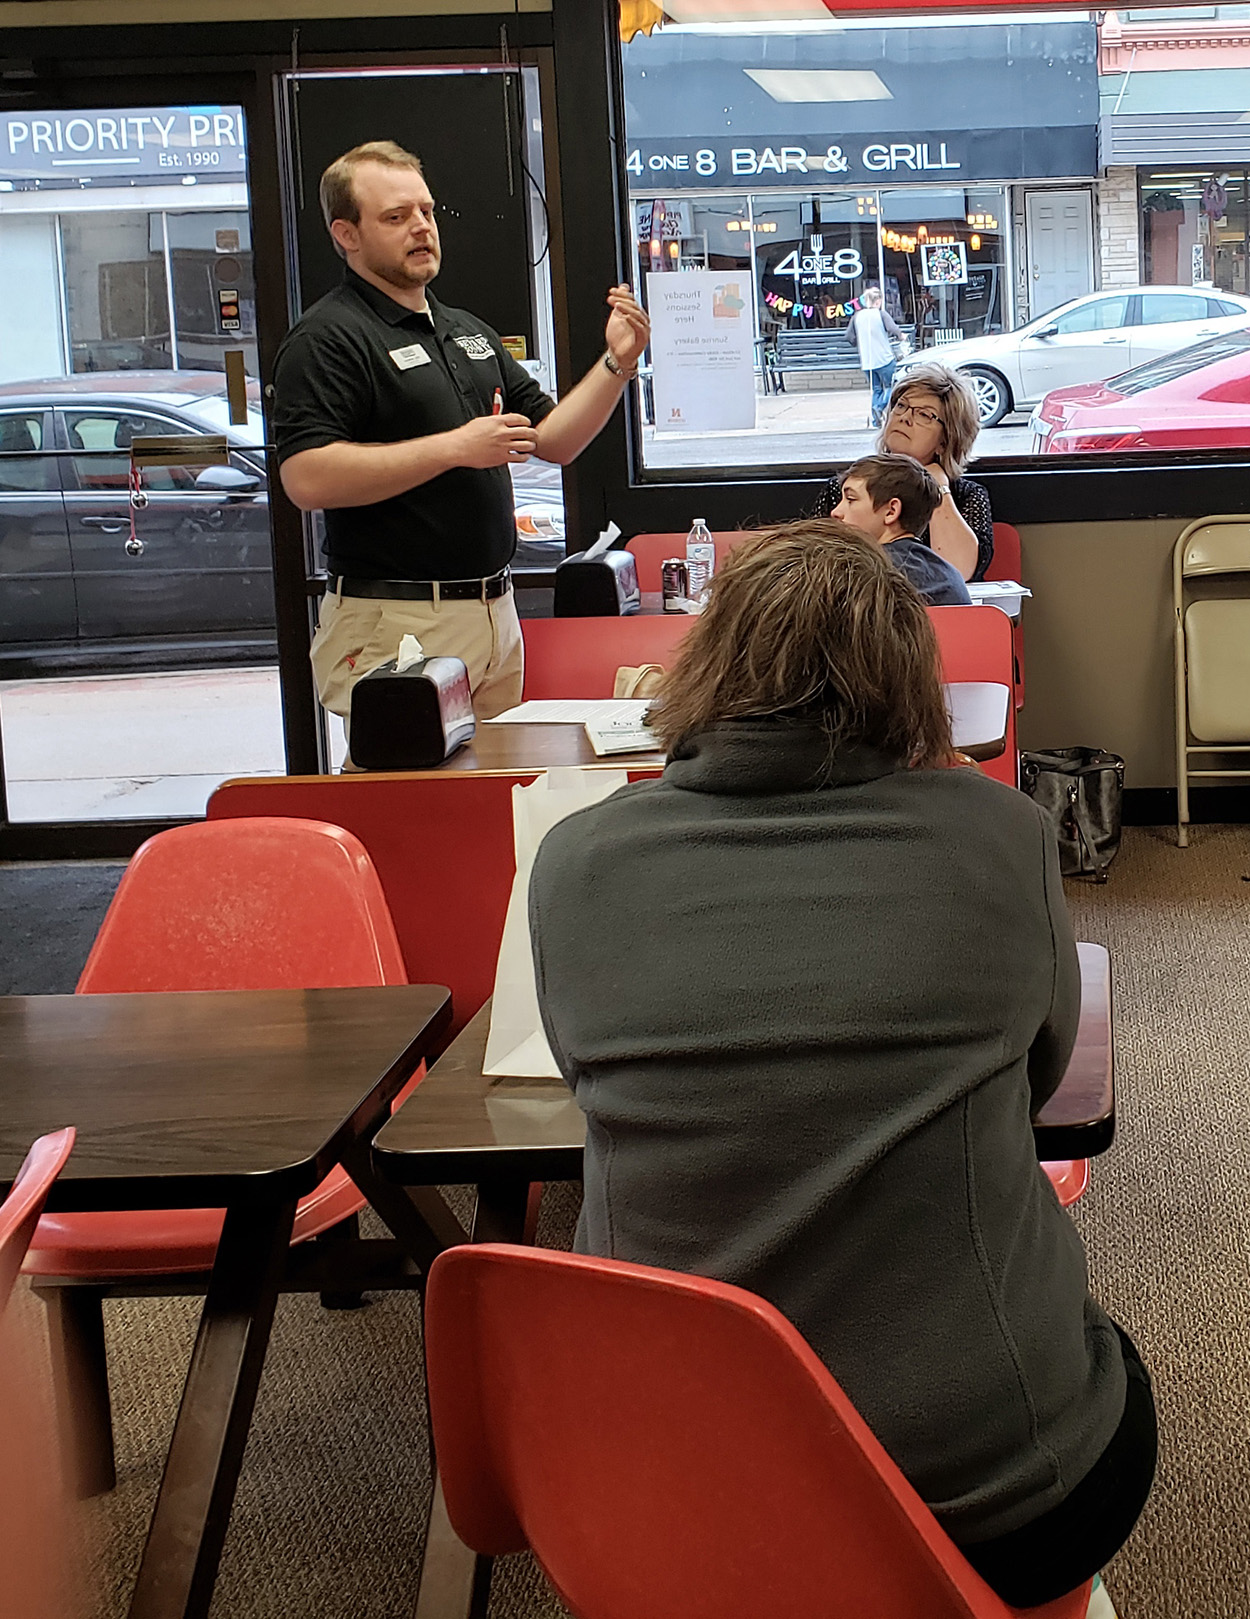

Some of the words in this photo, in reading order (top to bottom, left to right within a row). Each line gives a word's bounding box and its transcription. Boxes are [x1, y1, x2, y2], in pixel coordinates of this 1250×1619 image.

[7, 115, 176, 154] PRIORITY
[159, 153, 183, 167] Est.
[186, 151, 220, 166] 1990
[626, 149, 644, 176] 4
[648, 154, 690, 172] ONE
[695, 149, 717, 176] 8
[731, 147, 809, 176] BAR
[822, 145, 849, 173] &
[862, 143, 961, 171] GRILL
[773, 250, 804, 280] 4
[802, 258, 833, 271] ONE
[833, 248, 864, 280] 8
[802, 277, 817, 285] BAR
[765, 291, 814, 318] HAPPY
